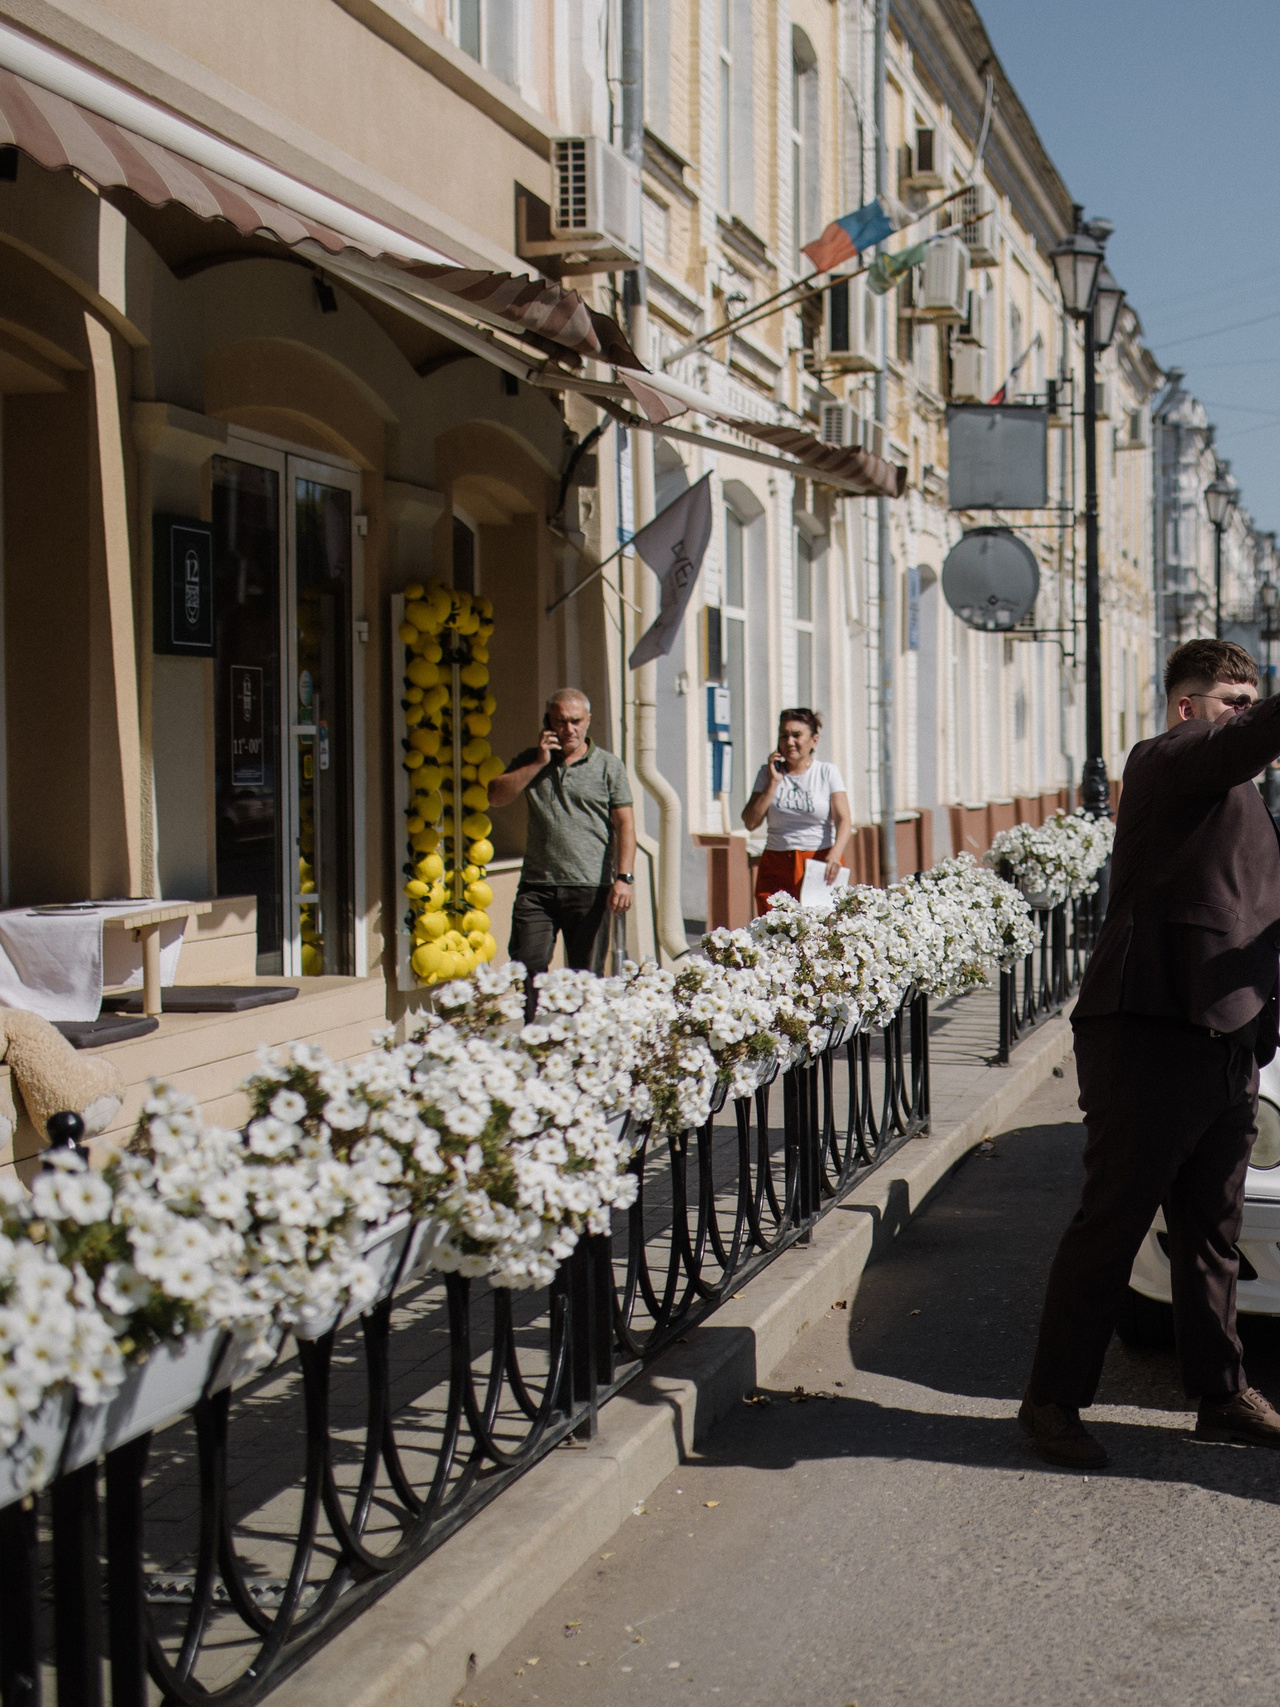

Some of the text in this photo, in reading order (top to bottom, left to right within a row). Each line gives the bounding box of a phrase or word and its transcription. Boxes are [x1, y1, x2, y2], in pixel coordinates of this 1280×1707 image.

[185, 559, 199, 582] 12
[777, 787, 812, 801] LOVE
[776, 799, 815, 813] CLUB
